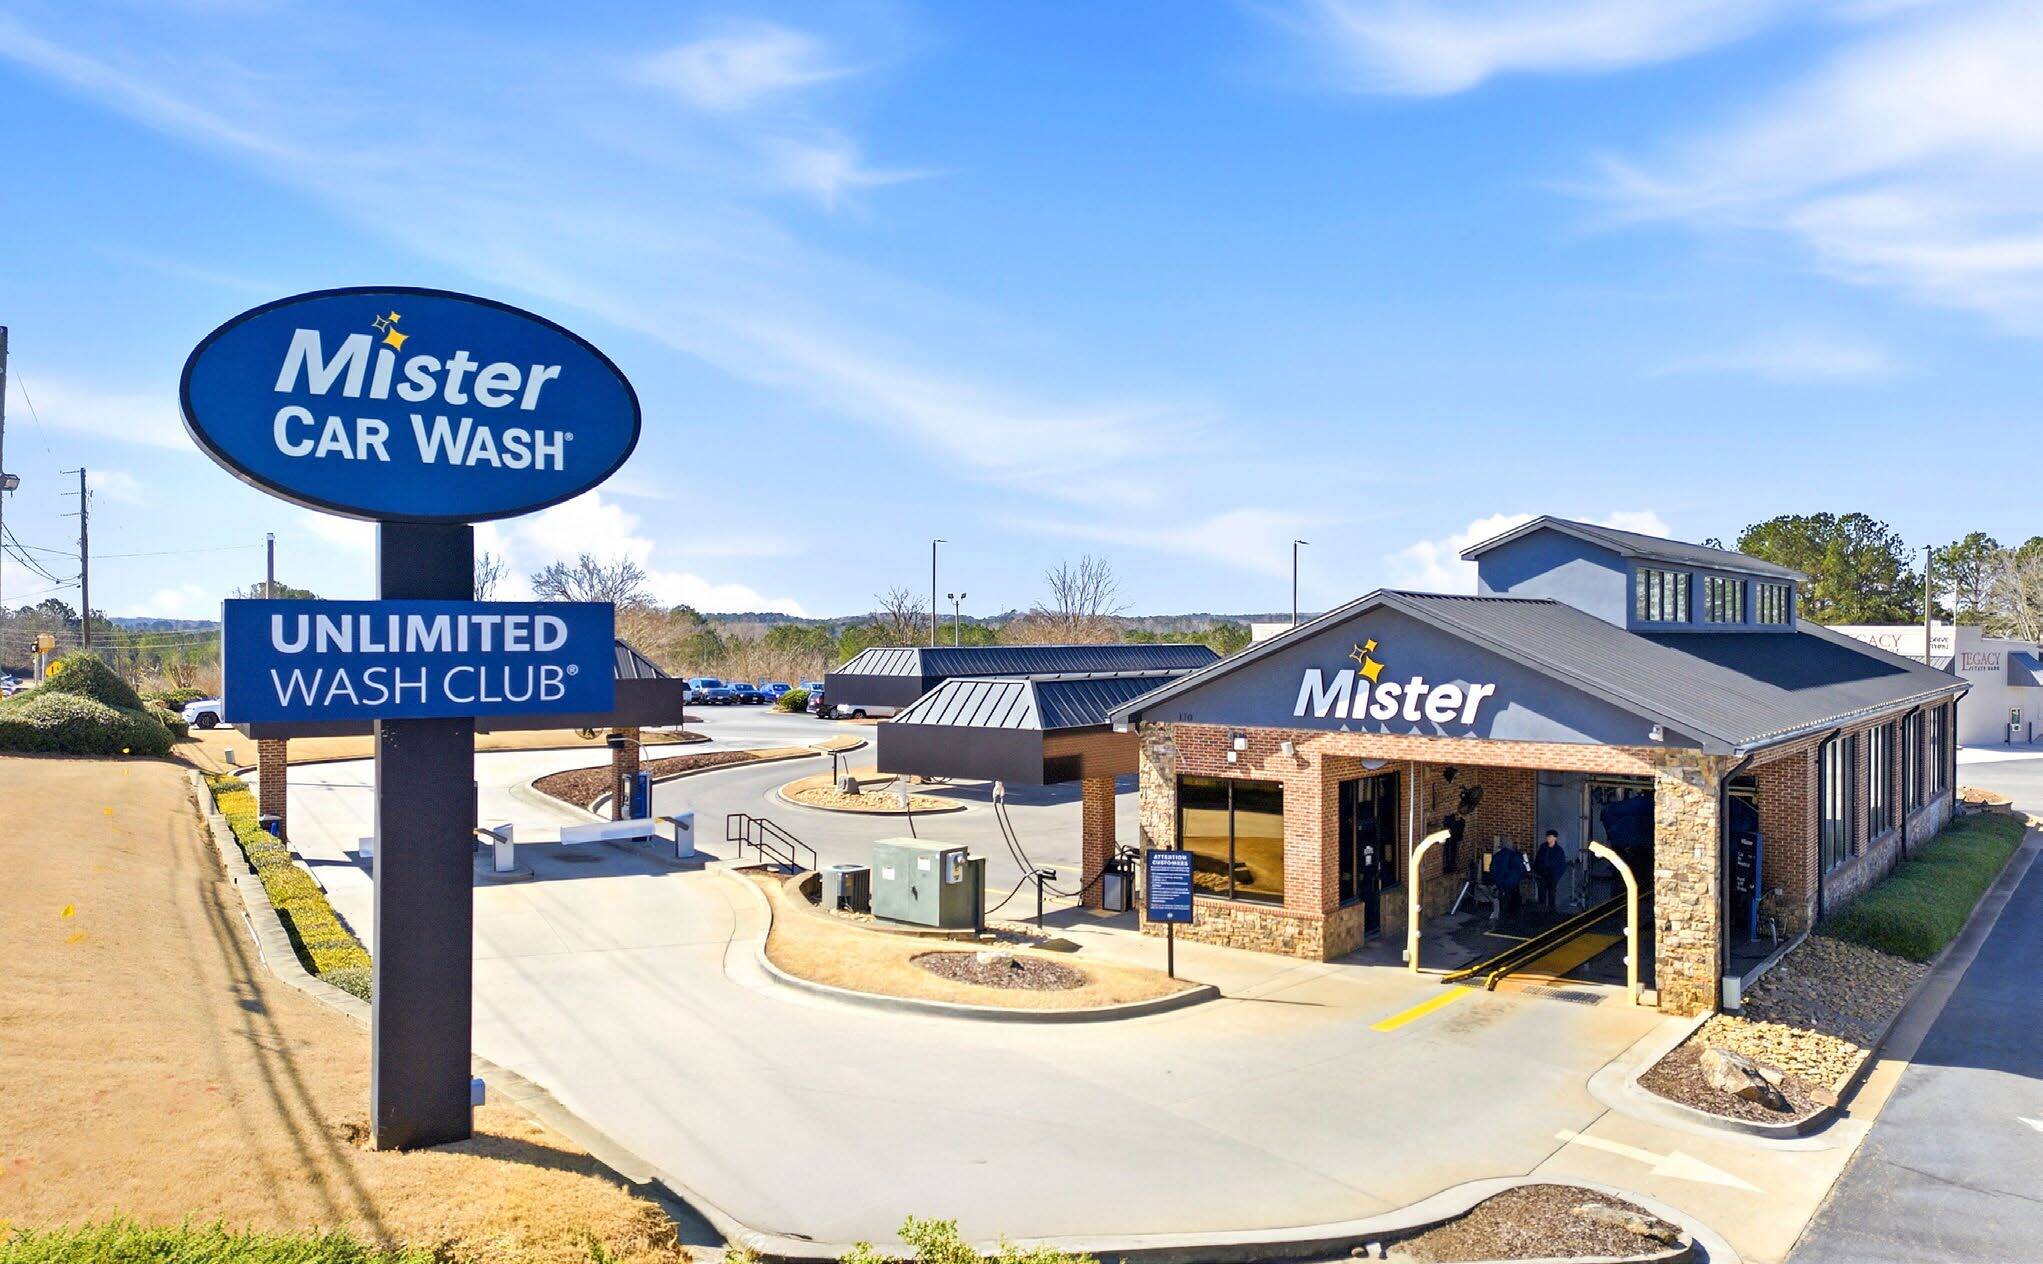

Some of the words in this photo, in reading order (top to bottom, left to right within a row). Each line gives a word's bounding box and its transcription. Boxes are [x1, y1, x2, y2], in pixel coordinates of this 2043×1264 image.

[275, 328, 562, 411] Mister
[274, 406, 391, 463] CAR
[271, 614, 568, 654] UNLIMITED
[1961, 652, 2001, 671] LEGACY
[271, 666, 428, 707] WASH
[1293, 662, 1496, 725] Mister
